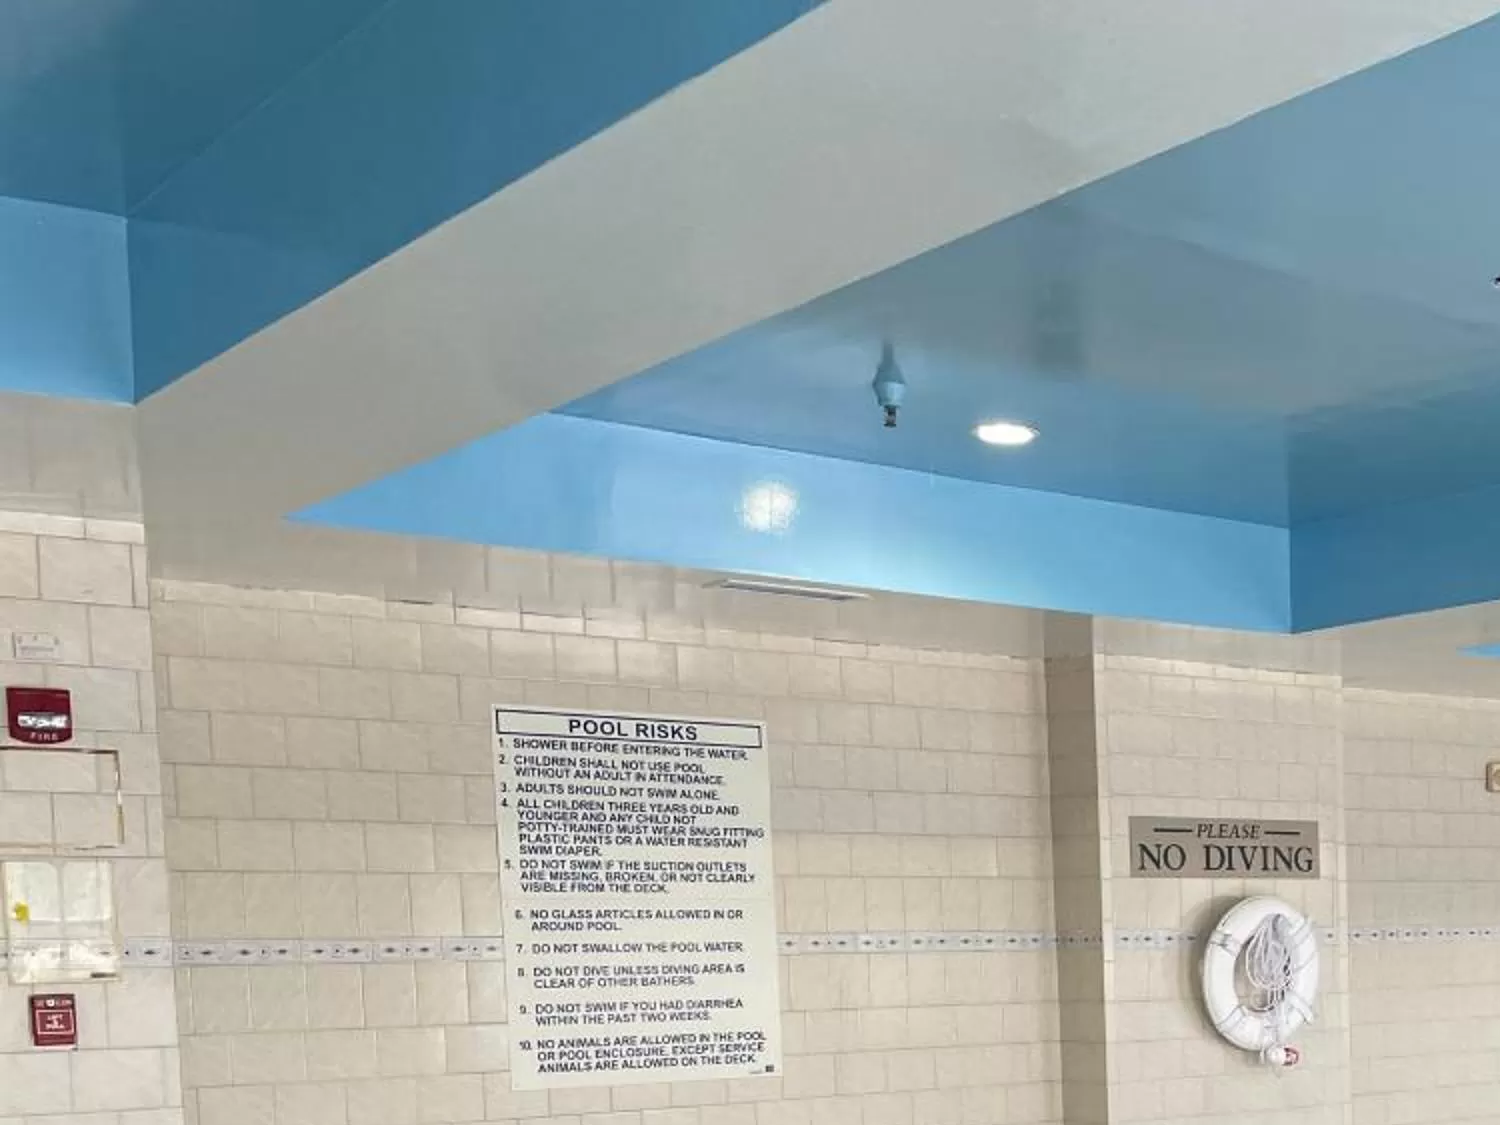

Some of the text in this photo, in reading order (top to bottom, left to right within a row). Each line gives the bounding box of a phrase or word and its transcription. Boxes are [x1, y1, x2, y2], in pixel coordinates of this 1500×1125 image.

[569, 719, 698, 741] POOL RISKS
[513, 738, 567, 749] SHOWER
[571, 741, 619, 753] BEFORE
[622, 744, 681, 756] ENTERING
[684, 747, 705, 758] THE
[513, 756, 577, 767] CHILDREN
[580, 758, 618, 769] SHALL
[621, 760, 645, 770] NOT
[648, 761, 671, 772] USE
[674, 763, 705, 773] POOL
[514, 767, 570, 778] WITHOUT
[573, 769, 590, 779] AN
[593, 770, 632, 781] ADULT
[636, 772, 647, 781] IN
[516, 783, 564, 794] ADULTS
[567, 785, 617, 796] SHOULD
[620, 787, 644, 797] NOT
[647, 788, 677, 798] SWIM
[517, 799, 541, 808] ALL
[543, 800, 605, 811] CHILDREN
[608, 801, 647, 812] THREE
[649, 803, 687, 814] YEARS
[690, 805, 714, 815] OLD
[716, 806, 740, 816] AND
[517, 810, 697, 825] YOUNGER AND ANY CHILD NOT
[518, 822, 765, 839] POTTY-TRAINED MUST WEAR SNUG FITTING
[1197, 823, 1261, 841] PLEASE
[519, 834, 748, 848] PLASTIC PANTS OR A WATER RESISTANT
[519, 846, 553, 856] SWIM
[1138, 843, 1313, 872] NO DIVING
[520, 859, 539, 869] DO
[541, 860, 566, 870] NOT
[569, 860, 601, 870] SWIM
[605, 860, 615, 870] IF
[618, 861, 640, 871] THE
[643, 861, 694, 871] SUCTION
[696, 862, 748, 872] OUTLETS
[520, 871, 546, 881] ARE
[659, 873, 677, 882] OR
[680, 873, 703, 883] NOT
[705, 873, 755, 883] CLEARLY
[521, 883, 568, 893] VISIBLE
[570, 883, 605, 893] FROM
[608, 883, 632, 893] THE
[530, 909, 549, 919] NO
[551, 909, 593, 919] GLASS
[595, 909, 653, 919] ARTICLES
[655, 909, 711, 919] ALLOWED
[714, 909, 725, 919] IN
[727, 909, 743, 919] OR
[531, 921, 585, 931] AROUND
[532, 943, 551, 954] DO
[553, 943, 579, 953] NOT
[581, 943, 643, 953] SWALLOW
[646, 942, 669, 953] THE
[671, 942, 703, 952] POOL
[533, 967, 553, 977] DO
[555, 966, 580, 977] NOT
[583, 966, 610, 976] DIVE
[613, 965, 659, 975] UNLESS
[662, 964, 700, 975] DIVING
[702, 963, 733, 974] AREA
[735, 963, 746, 973] IS
[534, 978, 575, 989] CLEAR
[578, 978, 595, 988] OF
[597, 977, 639, 988] OTHER
[535, 1003, 554, 1014] DO
[556, 1003, 581, 1013] NOT
[585, 1002, 617, 1012] SWIM
[620, 1001, 629, 1011] IF
[632, 1001, 657, 1011] YOU
[660, 1000, 684, 1010] HAD
[686, 998, 744, 1009] DIARRHEA
[535, 1015, 579, 1026] WITHIN
[582, 1014, 605, 1025] THE
[607, 1013, 637, 1024] PAST
[640, 1012, 667, 1022] TWO
[537, 1040, 555, 1049] NO
[557, 1038, 611, 1049] ANIMALS
[613, 1036, 638, 1047] ARE
[640, 1034, 697, 1046] ALLOWED
[699, 1033, 710, 1043] IN
[713, 1032, 735, 1042] THE
[737, 1031, 767, 1041] POOL
[537, 1051, 556, 1062] OR
[559, 1049, 592, 1061] POOL
[671, 1044, 717, 1055] EXCEPT
[719, 1042, 765, 1053] SERVICE
[538, 1062, 593, 1073] ANIMALS
[594, 1060, 619, 1071] ARE
[621, 1058, 679, 1069] ALLOWED
[681, 1057, 698, 1067] ON
[701, 1055, 722, 1065] THE
